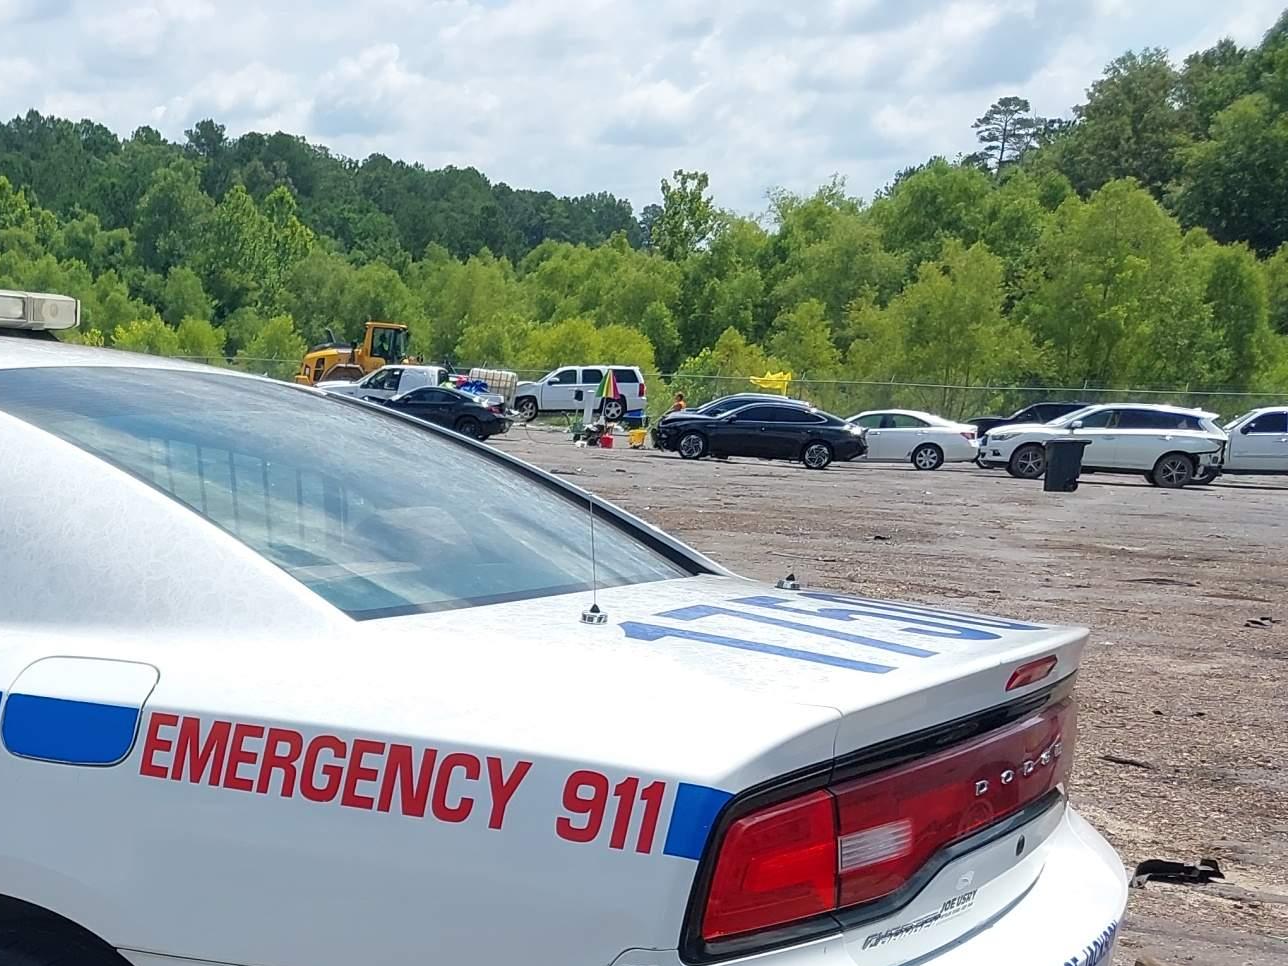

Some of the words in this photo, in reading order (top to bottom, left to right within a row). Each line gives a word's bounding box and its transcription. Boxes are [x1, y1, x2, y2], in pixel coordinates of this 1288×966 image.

[138, 711, 533, 830] EMERGENCY
[555, 770, 666, 855] 911
[976, 742, 1063, 796] DODGE
[940, 898, 959, 913] JOE
